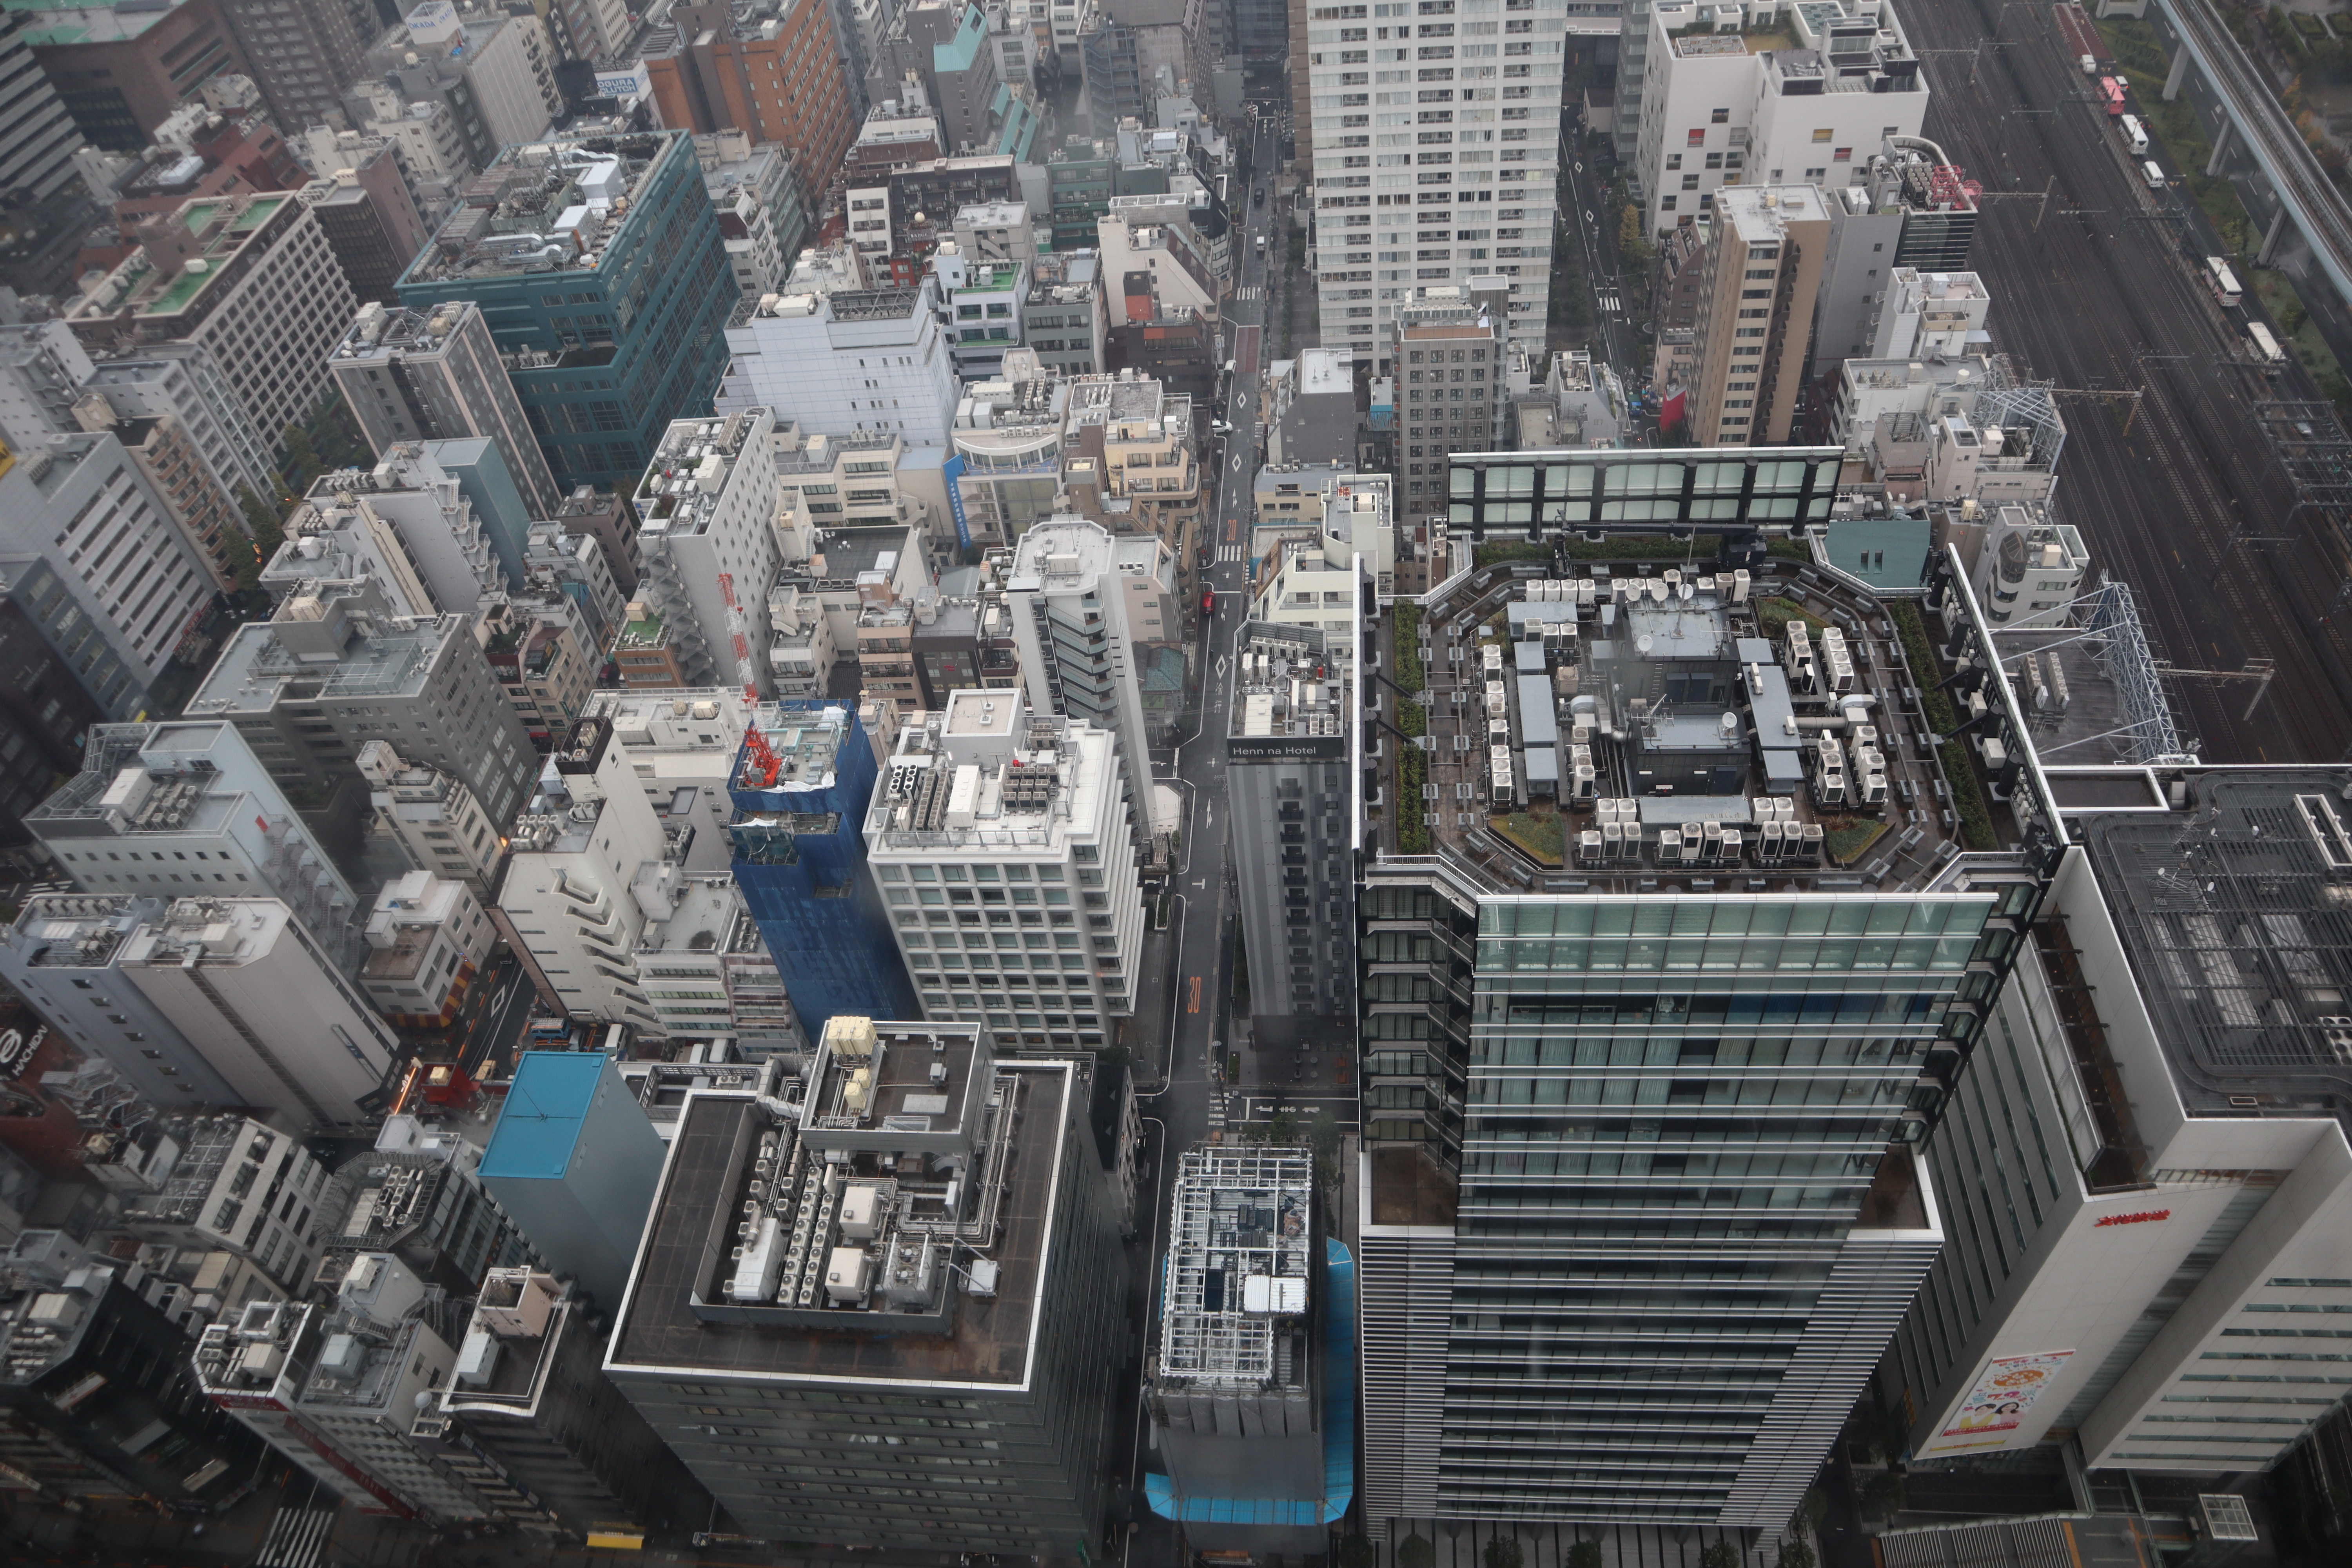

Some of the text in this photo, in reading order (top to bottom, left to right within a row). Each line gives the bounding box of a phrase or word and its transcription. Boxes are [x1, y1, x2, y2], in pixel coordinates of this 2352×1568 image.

[408, 21, 437, 29] OKADA
[597, 79, 633, 88] OGURA
[600, 85, 636, 94] CLUTCH
[1227, 519, 1236, 541] 30
[1286, 746, 1316, 755] Hotel
[1187, 977, 1201, 1013] 30
